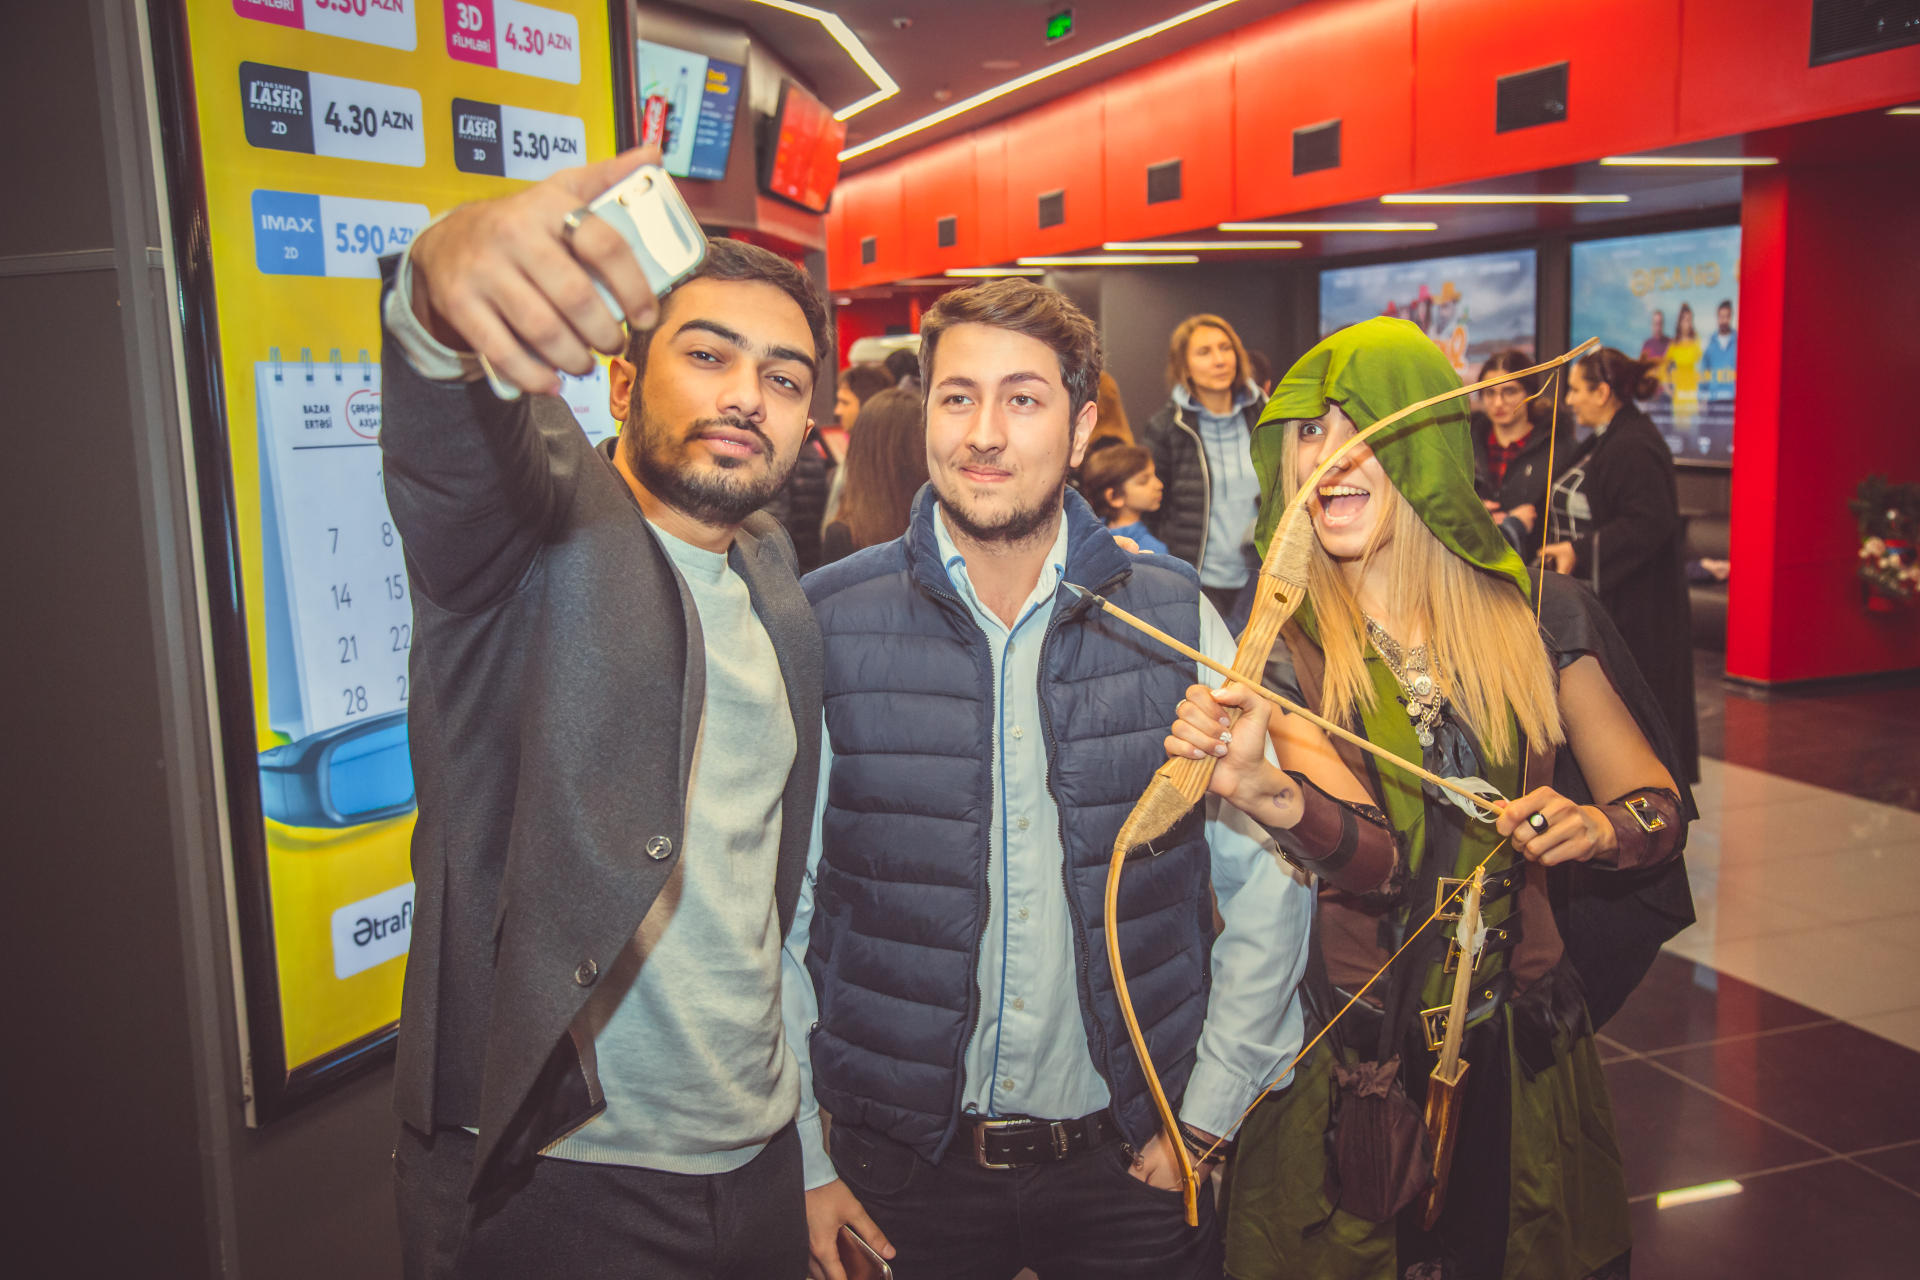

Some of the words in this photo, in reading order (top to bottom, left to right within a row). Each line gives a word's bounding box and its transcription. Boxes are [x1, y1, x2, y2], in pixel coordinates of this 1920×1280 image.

[457, 2, 483, 31] 3D
[504, 22, 545, 56] 4.30
[547, 32, 572, 52] AZN
[249, 81, 304, 110] LASER
[271, 121, 288, 135] 2D
[324, 101, 378, 138] 4.30
[381, 110, 414, 131] AZN
[458, 114, 498, 139] LASER
[512, 130, 550, 161] 5.30
[552, 137, 577, 154] AZN
[261, 214, 316, 233] IMAX
[335, 222, 385, 255] 5.90
[283, 246, 299, 260] 2D
[328, 528, 339, 555] 7
[381, 521, 394, 548] 8
[331, 582, 352, 611] 14
[385, 574, 404, 601] 15
[338, 634, 358, 664] 21
[390, 623, 411, 652] 22
[343, 685, 368, 716] 28
[397, 675, 409, 702] 2
